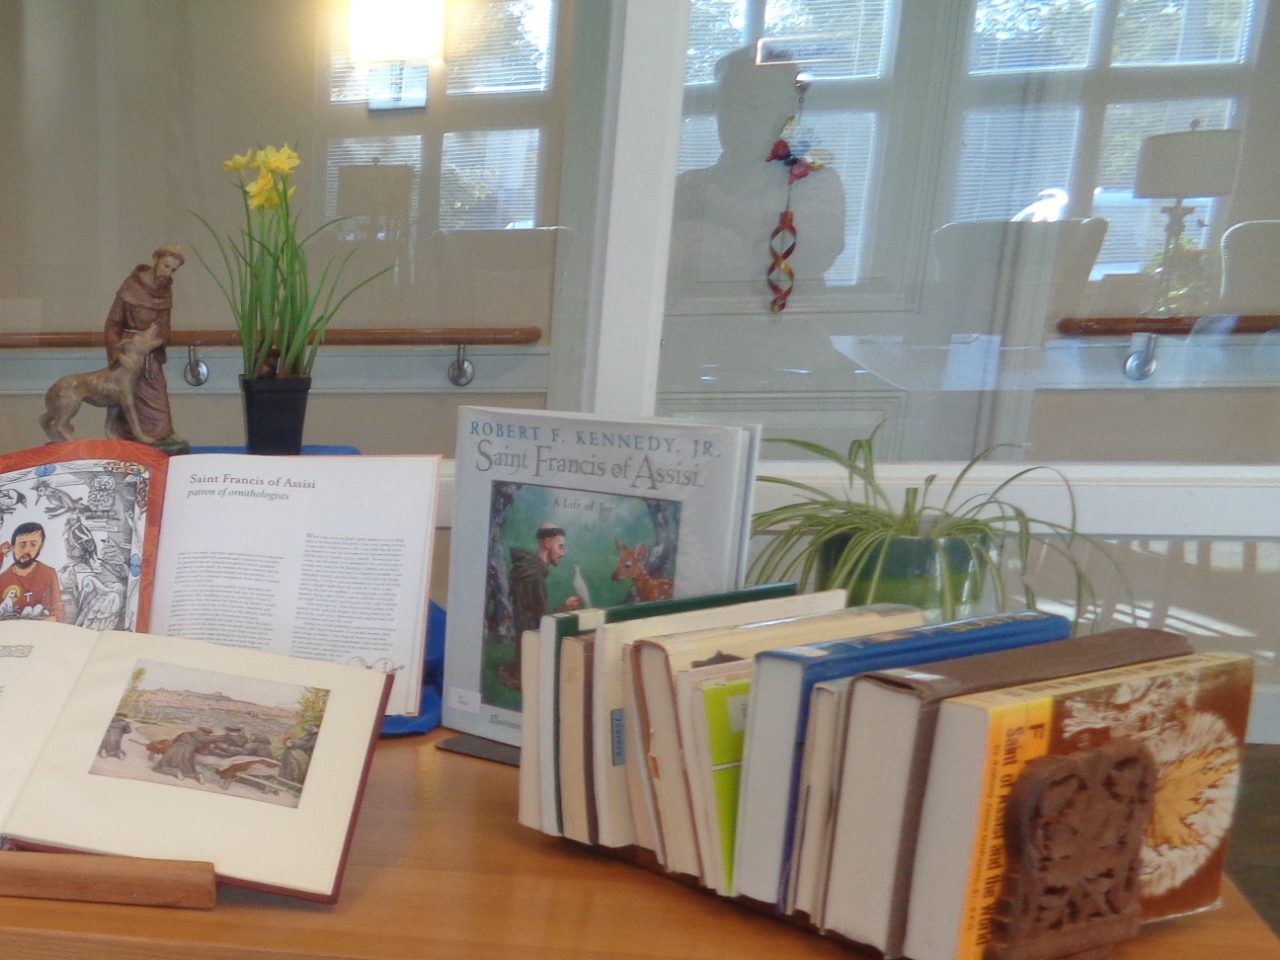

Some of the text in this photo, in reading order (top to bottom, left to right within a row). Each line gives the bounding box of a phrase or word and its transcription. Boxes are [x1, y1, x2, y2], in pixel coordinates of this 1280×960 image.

[470, 421, 540, 440] ROBERT
[552, 429, 566, 443] F.
[691, 440, 721, 459] JR.
[476, 439, 705, 490] Saint Francis of Assisi
[187, 488, 290, 501] patron of ornithologists
[190, 474, 316, 489] Saint Francis of Assisi
[1003, 727, 1024, 766] Saint
[987, 844, 1002, 870] and
[983, 874, 1002, 898] the
